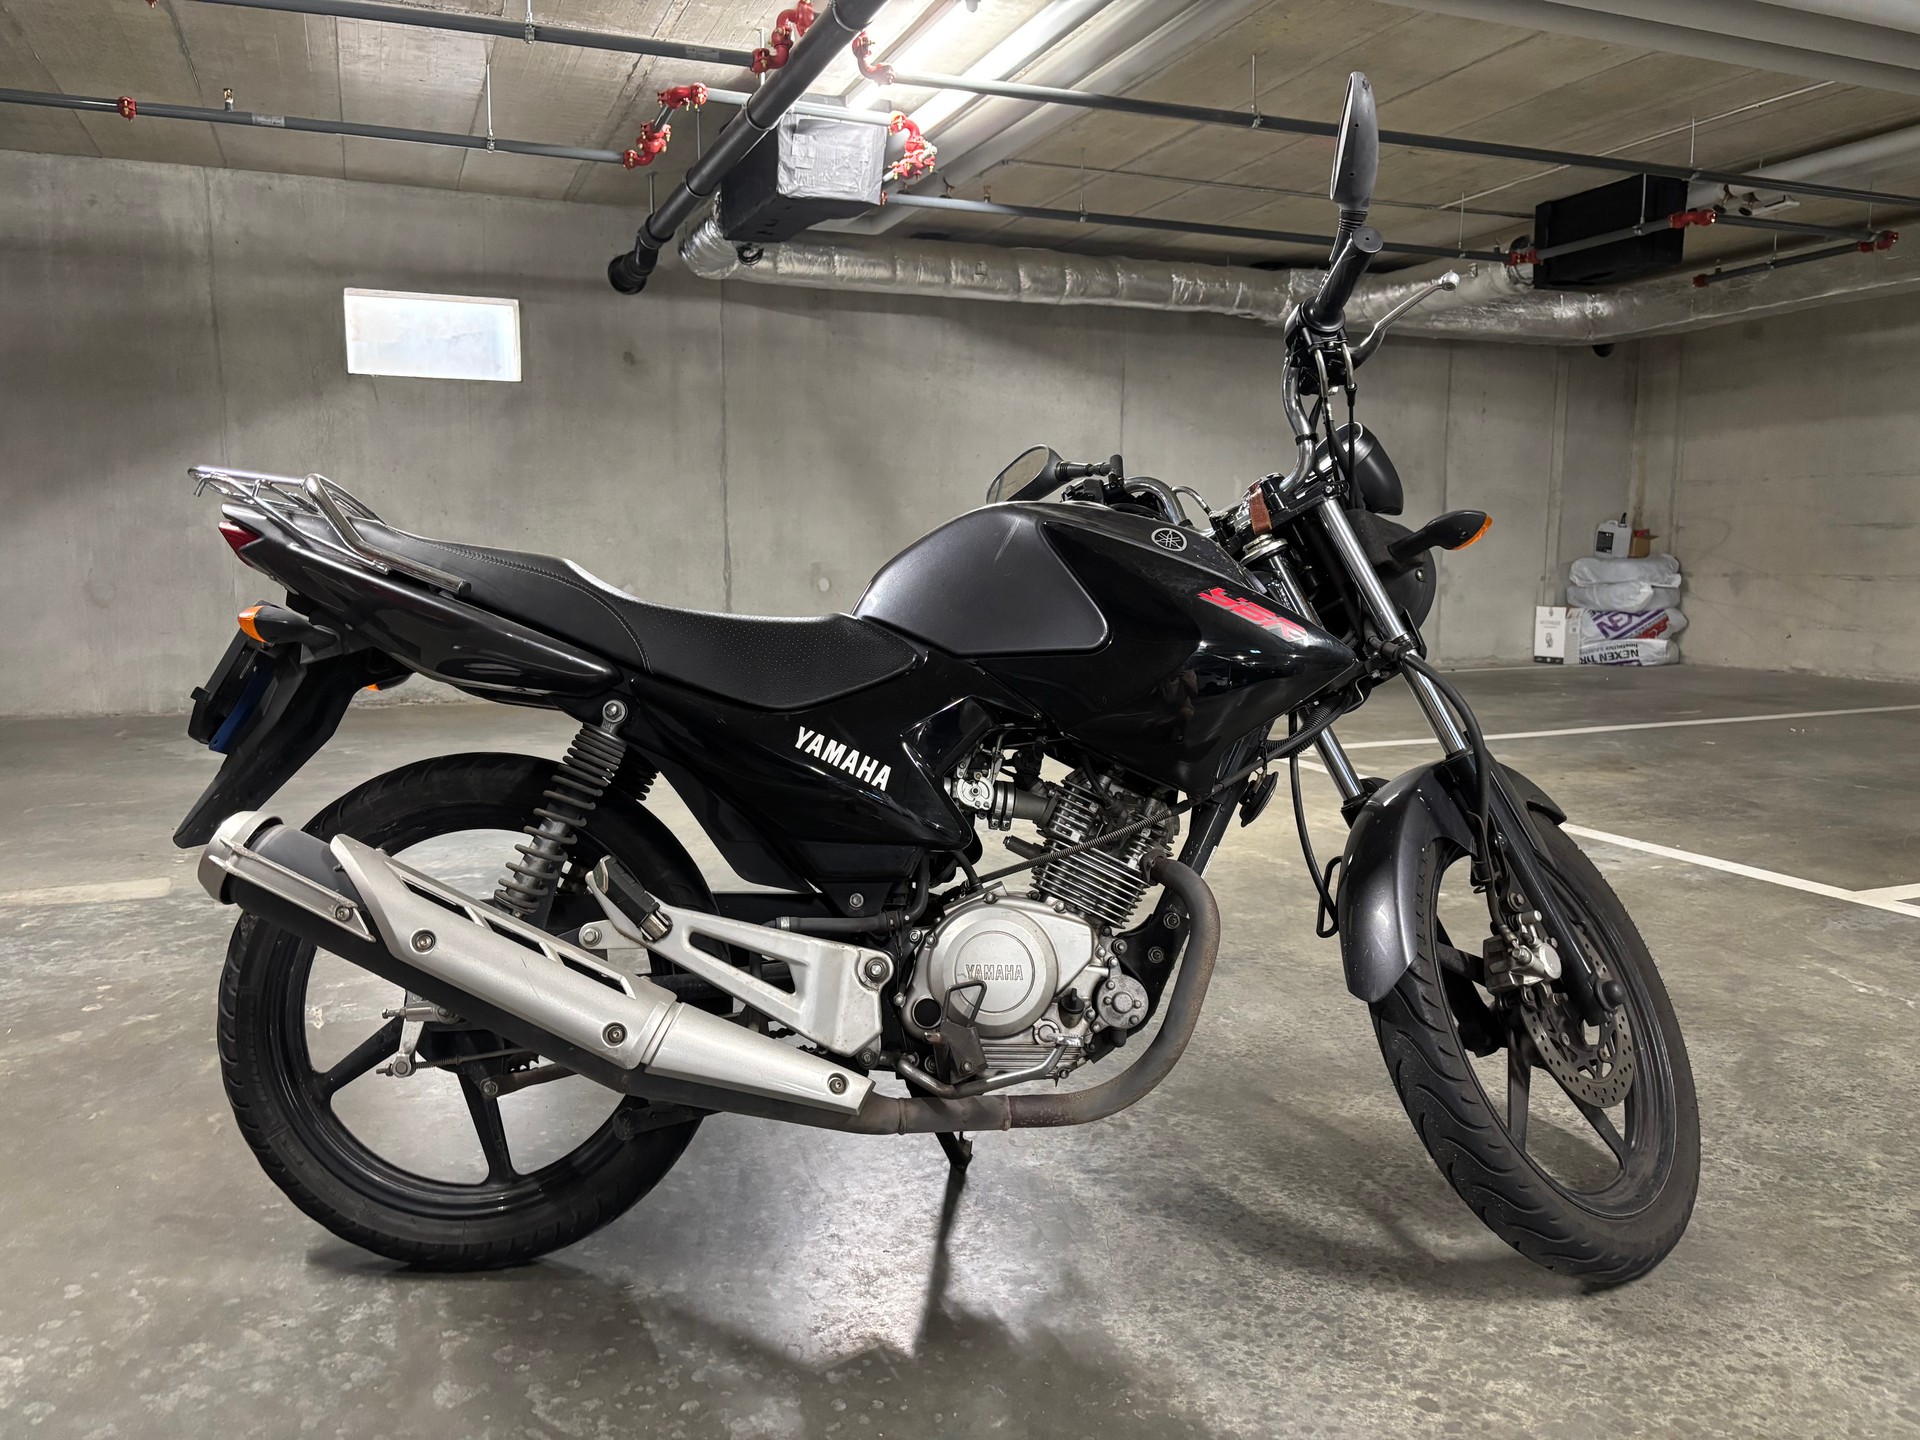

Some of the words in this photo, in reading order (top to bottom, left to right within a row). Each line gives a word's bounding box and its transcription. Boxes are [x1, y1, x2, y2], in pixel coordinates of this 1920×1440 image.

[1580, 655, 1598, 664] TIR
[1599, 649, 1639, 662] NEXEN
[794, 725, 892, 792] YAMAHA
[965, 964, 1024, 981] YAMAHA
